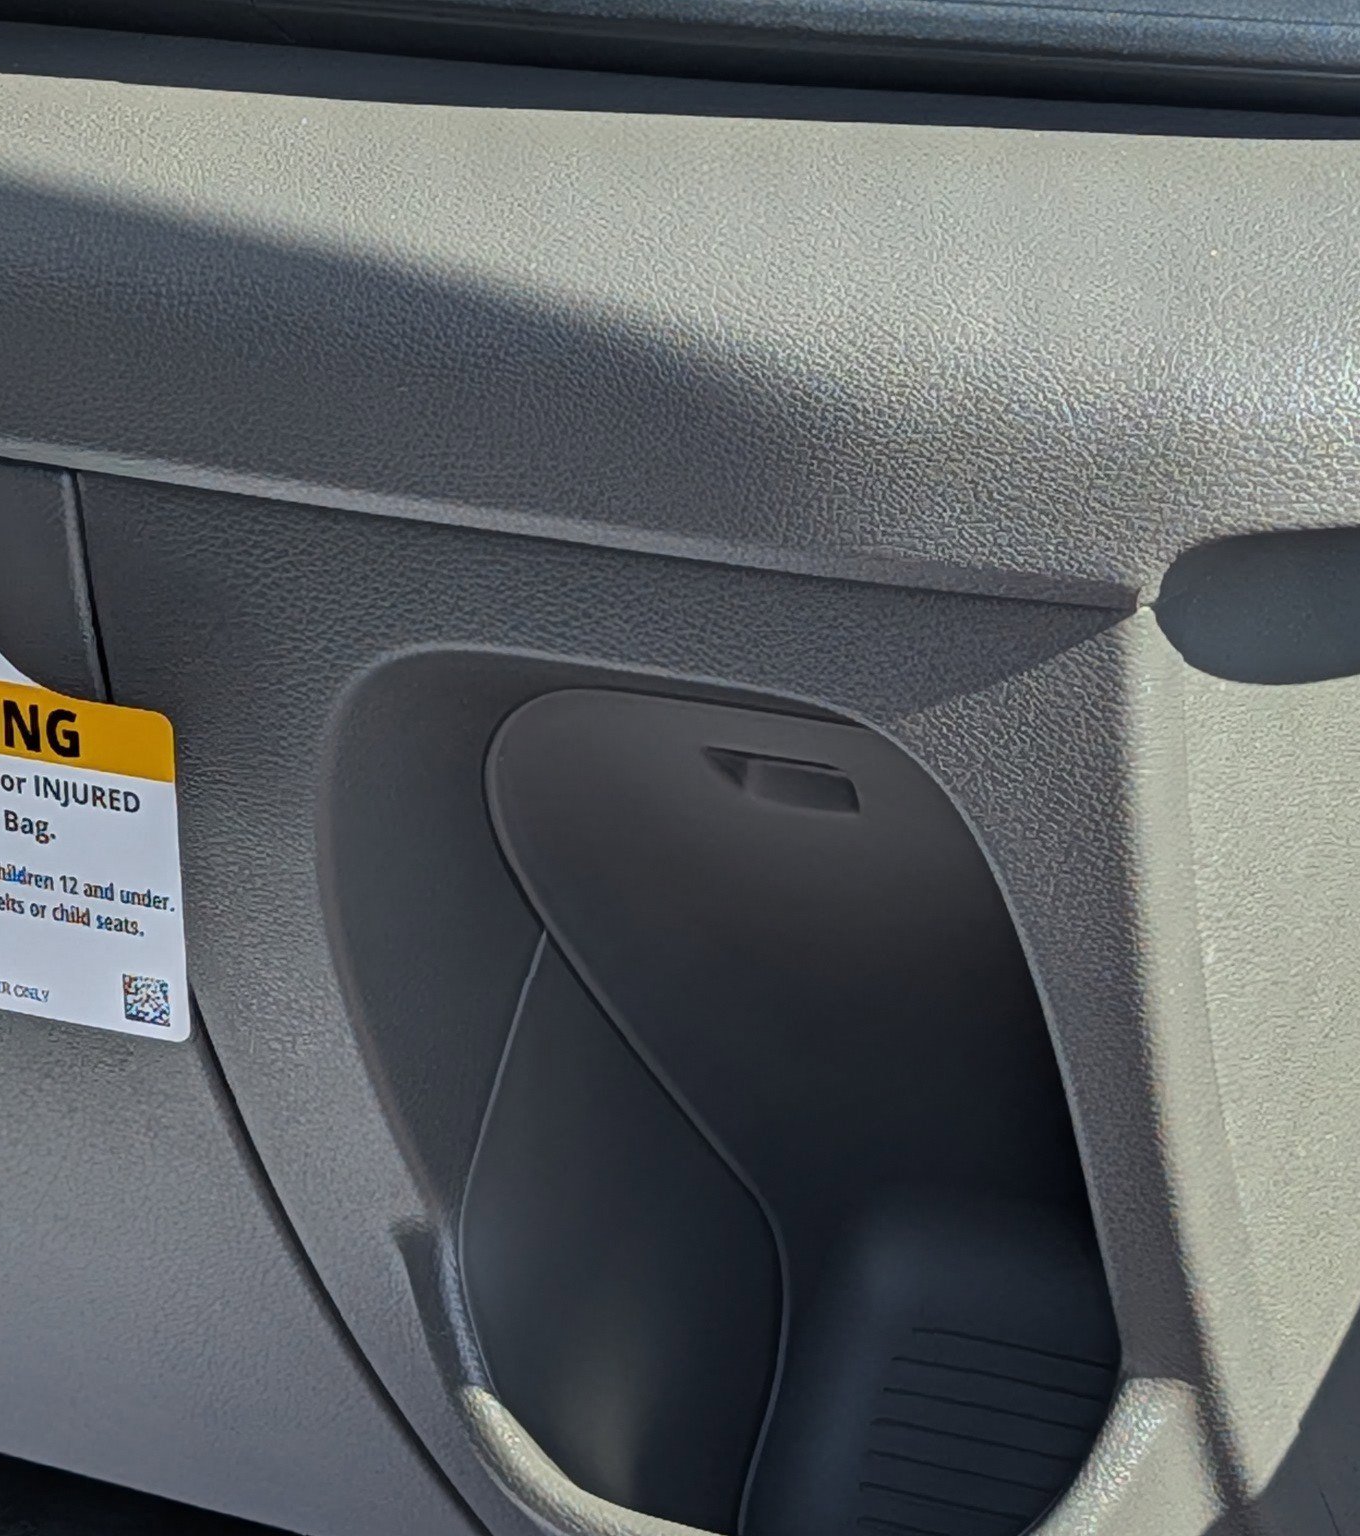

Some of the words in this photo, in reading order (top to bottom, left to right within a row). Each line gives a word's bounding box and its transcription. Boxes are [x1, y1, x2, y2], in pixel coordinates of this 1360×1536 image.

[0, 774, 27, 794] or
[34, 774, 141, 813] INJURED
[4, 809, 57, 844] Bag.
[59, 875, 79, 896] 12
[83, 882, 115, 901] and
[120, 889, 176, 912] under.
[29, 901, 47, 919] or
[52, 903, 91, 928] child
[96, 914, 145, 937] seats.
